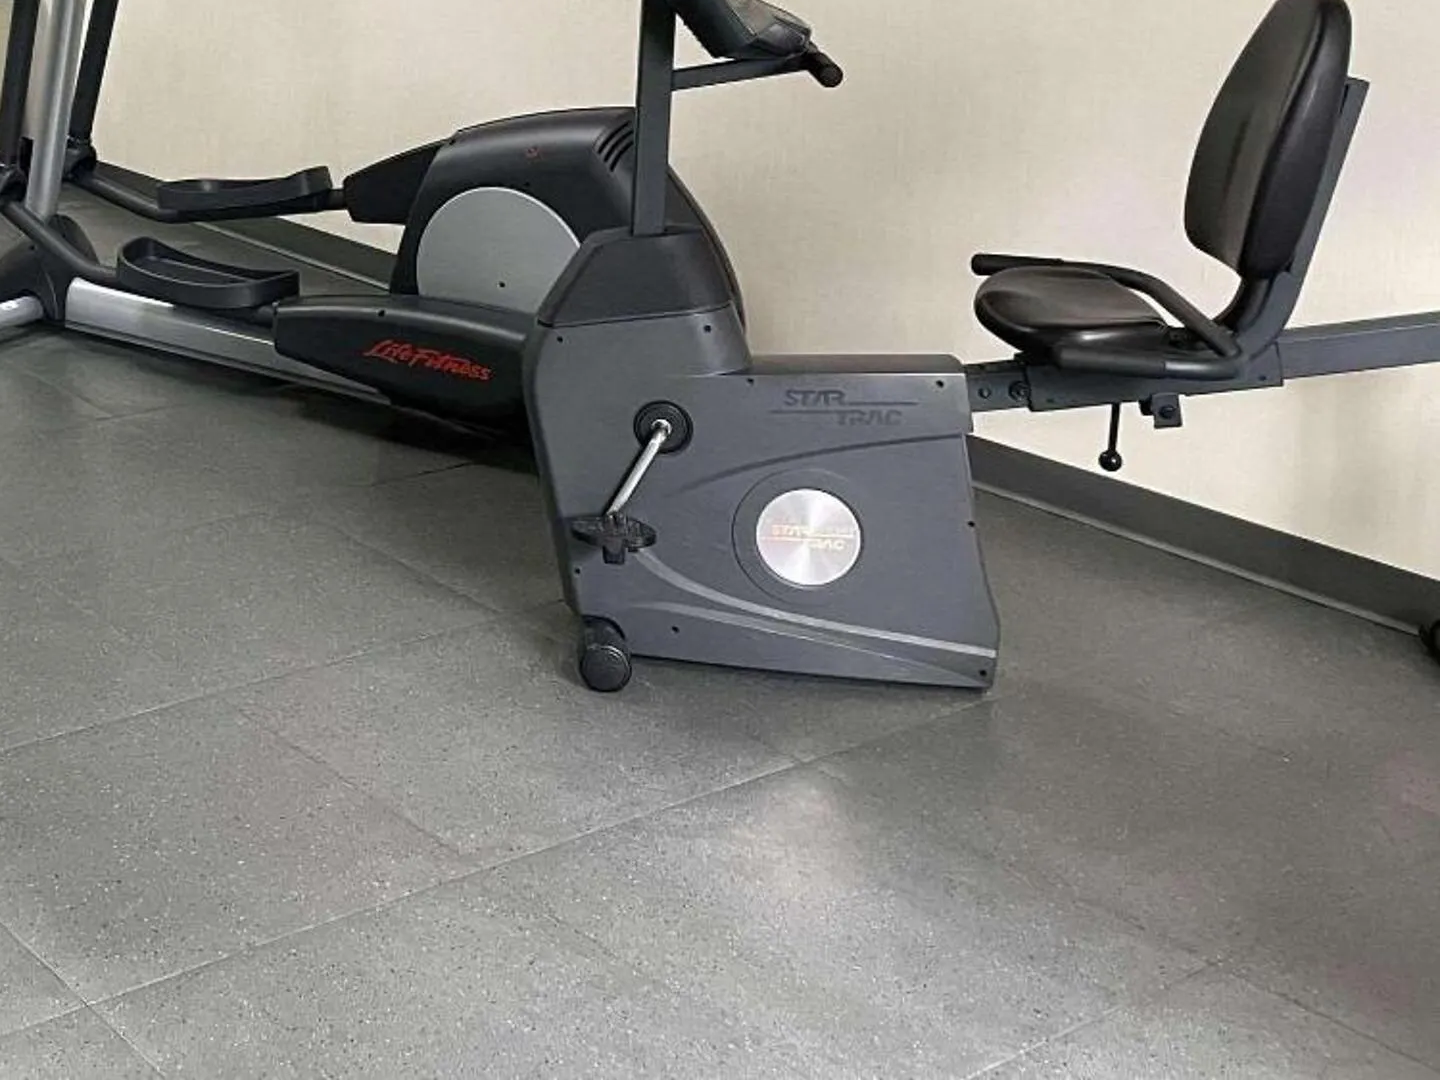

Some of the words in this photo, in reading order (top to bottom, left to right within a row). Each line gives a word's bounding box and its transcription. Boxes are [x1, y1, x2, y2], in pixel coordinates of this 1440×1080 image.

[363, 339, 414, 364] Life
[784, 389, 847, 407] STAR
[834, 408, 903, 426] TRAC
